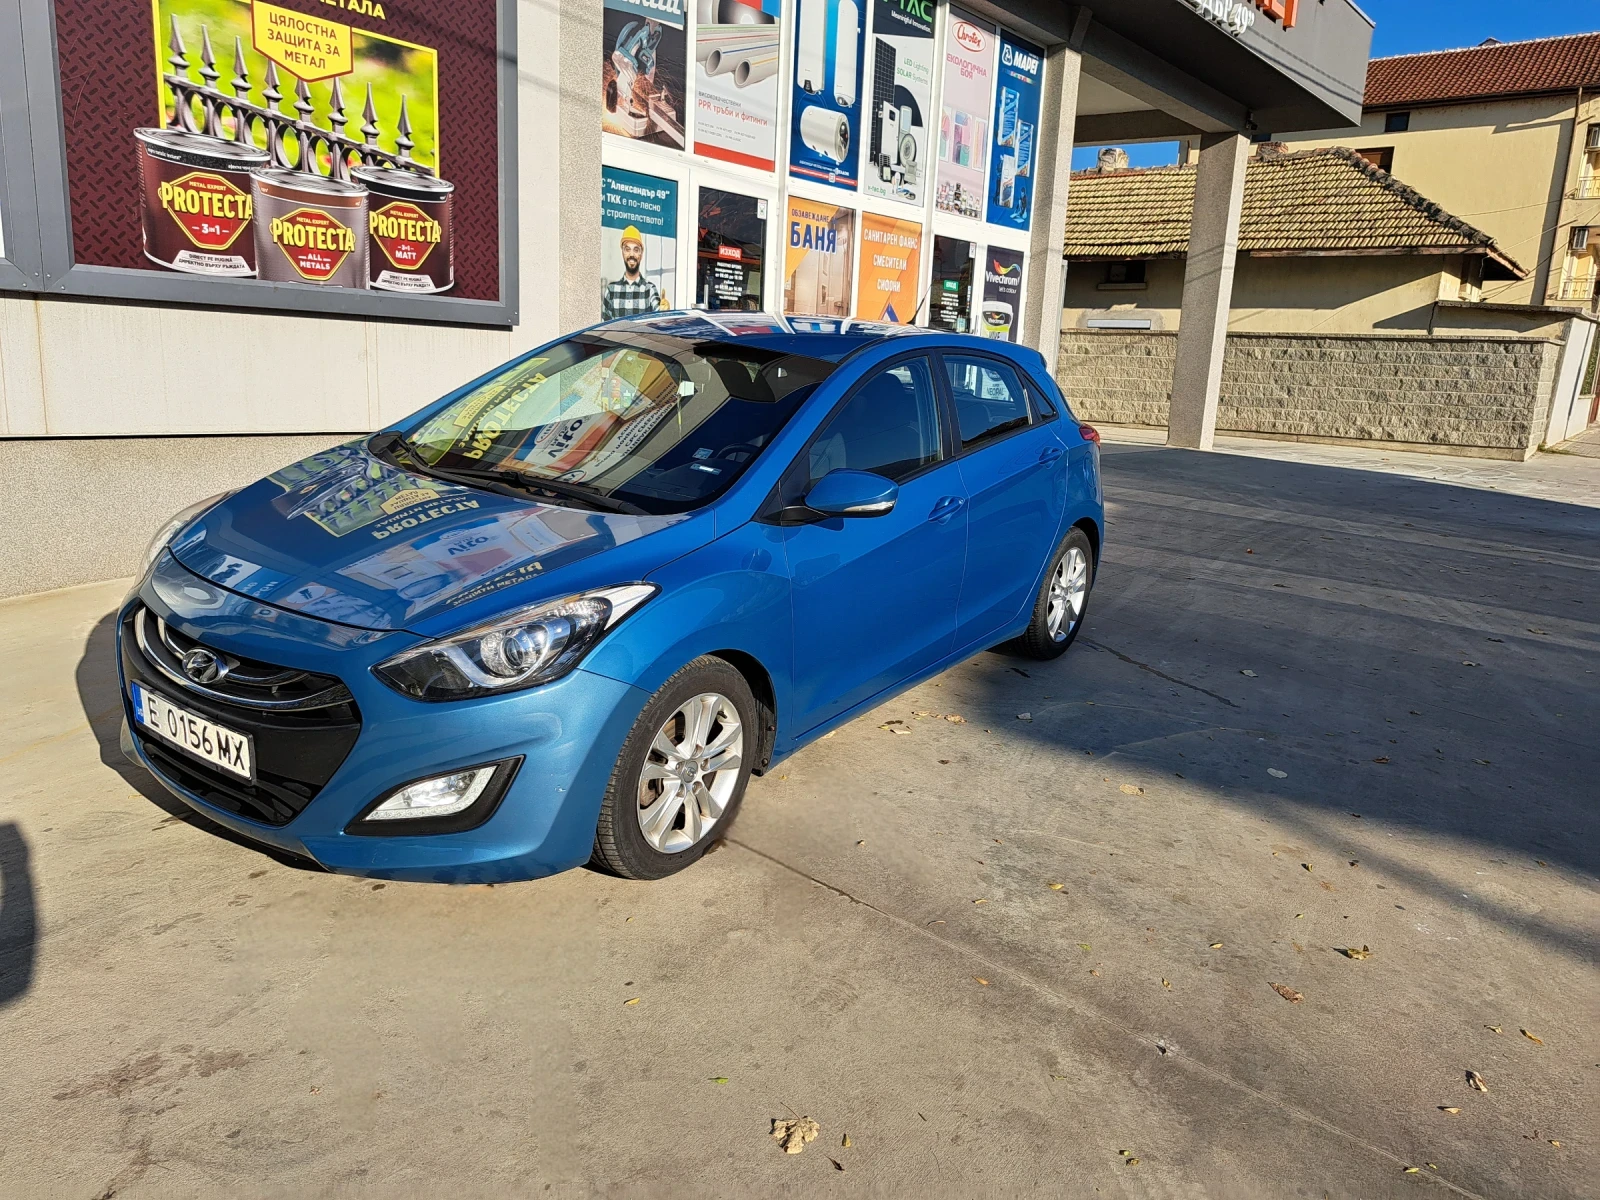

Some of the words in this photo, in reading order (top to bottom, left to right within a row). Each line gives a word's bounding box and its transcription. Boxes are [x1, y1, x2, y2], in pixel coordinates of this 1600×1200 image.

[269, 12, 337, 40] ЦЯЛОСТНА
[268, 29, 321, 52] ЗАЩИТА
[325, 44, 340, 57] ЗА
[284, 50, 326, 69] МЕТАЛ
[903, 57, 912, 67] LED
[946, 53, 987, 77] ЕКОЛОГИЧНА
[1013, 51, 1039, 75] MAPEI
[897, 67, 912, 79] SOLAR
[960, 67, 973, 80] БОЯ
[698, 98, 712, 111] PPR
[713, 104, 734, 117] тръби
[735, 111, 740, 119] и
[741, 111, 768, 127] фитинги
[161, 181, 253, 219] PROTECTA
[606, 193, 621, 205] ТКК
[622, 198, 627, 206] е
[628, 200, 661, 213] по-лесно
[606, 208, 664, 226] строителството!
[791, 208, 830, 223] ОБЗАВЕЖДАНЕ
[272, 218, 355, 252] PROTECTA
[369, 211, 441, 243] PROTECTA
[790, 221, 837, 253] БАНЯ
[864, 228, 898, 246] САНИТАРЕН
[308, 253, 322, 261] ALL
[395, 250, 417, 260] MATT
[873, 254, 907, 271] СМЕСИТЕЛИ
[299, 260, 331, 270] METALS
[877, 278, 901, 293] СИФОНИ
[148, 696, 160, 728] E
[168, 708, 213, 755] 0156
[216, 729, 245, 770] MX
